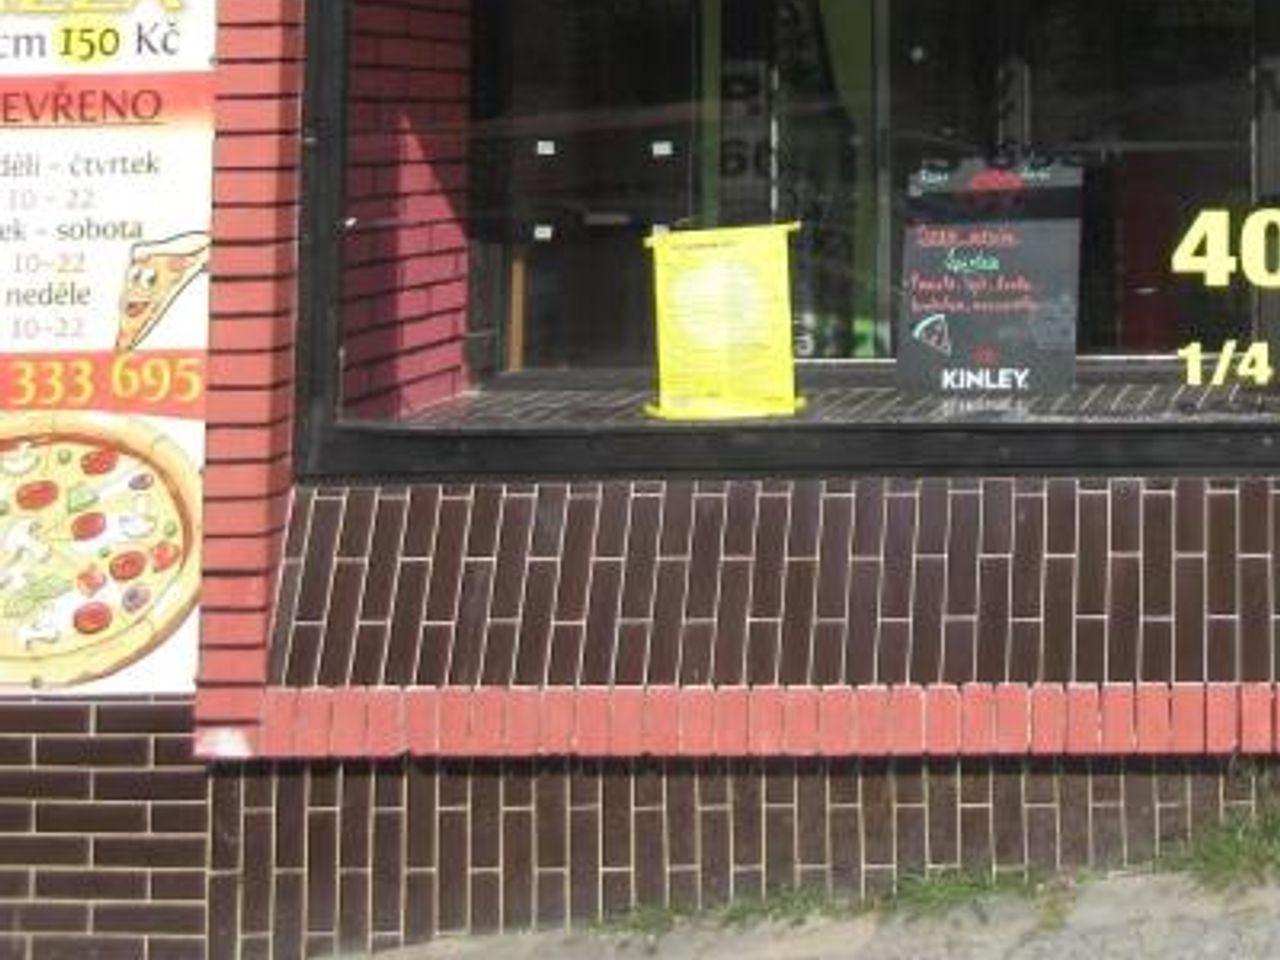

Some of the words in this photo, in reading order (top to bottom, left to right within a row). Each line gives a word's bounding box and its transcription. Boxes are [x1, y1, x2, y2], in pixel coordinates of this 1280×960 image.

[59, 26, 120, 61] 150
[136, 21, 181, 56] Kč
[2, 82, 162, 123] EVŘENO
[67, 151, 160, 177] čtvrtek
[56, 216, 145, 241] sobota
[5, 282, 92, 307] neděle
[941, 367, 1031, 390] KINLEY
[1177, 339, 1274, 386] 1/4
[10, 359, 95, 406] 333
[110, 354, 203, 403] 695
